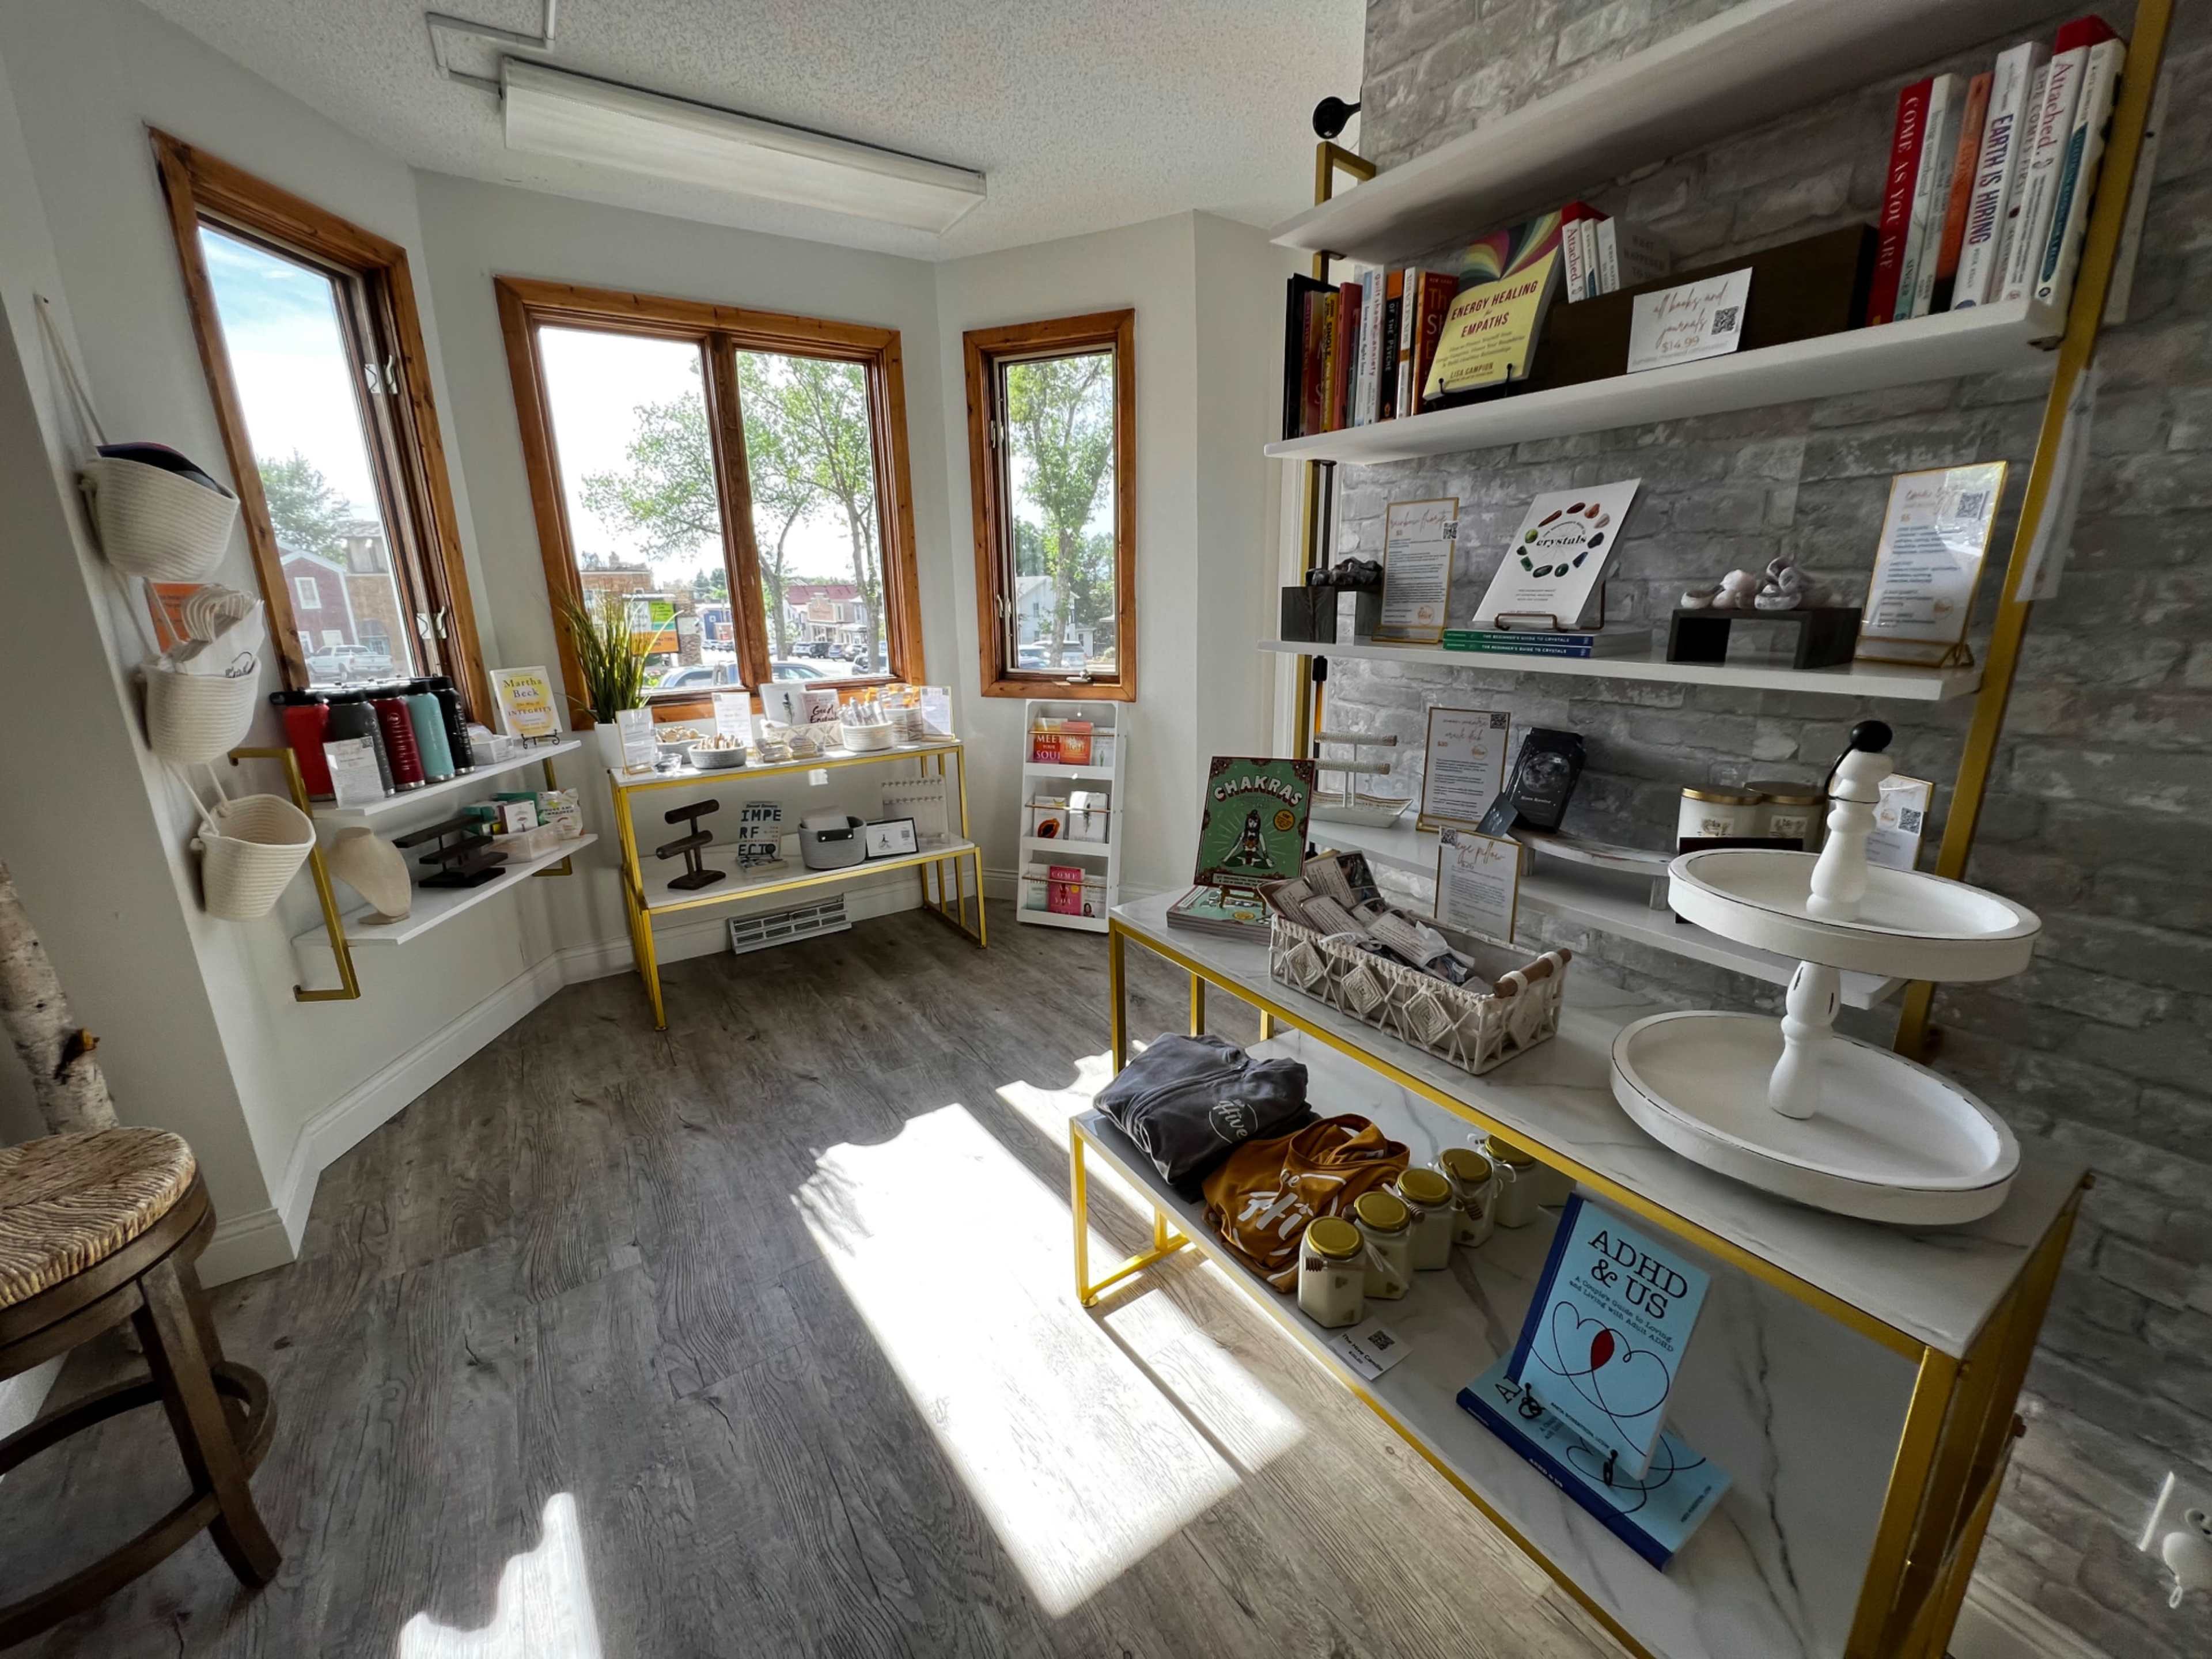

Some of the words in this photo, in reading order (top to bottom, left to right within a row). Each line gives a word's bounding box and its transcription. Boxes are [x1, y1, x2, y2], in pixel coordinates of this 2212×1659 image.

[2037, 63, 2073, 153] Attached.
[1897, 97, 1919, 154] COME
[1984, 113, 2014, 169] EARTH
[1893, 161, 1909, 183] AS
[1979, 169, 2001, 187] IS
[1885, 188, 1905, 224] YOU
[1969, 189, 2000, 246] HIRING
[1567, 229, 1582, 287] Attached.
[1878, 235, 1897, 270] ARE
[1429, 288, 1447, 310] Th
[1450, 296, 1490, 321] ENERGY
[1491, 281, 1539, 307] HEALING
[1461, 312, 1509, 338] EMPATHS
[1384, 339, 1395, 371] PSYCHE
[1536, 535, 1586, 548] crystals
[503, 677, 543, 688] Martha
[512, 687, 539, 698] Beck
[507, 706, 552, 716] INTEGRITY
[1036, 735, 1062, 743] MEET
[1214, 775, 1303, 806] CHAKRAS
[741, 809, 782, 822] IMPE
[739, 826, 759, 839] RF
[1051, 872, 1077, 880] COME
[1281, 1169, 1301, 1188] he
[1588, 1230, 1688, 1298] ADHD
[1591, 1259, 1618, 1289] &
[1625, 1275, 1668, 1319] US
[1569, 1280, 1582, 1292] and
[1583, 1289, 1606, 1309] Living
[1608, 1307, 1624, 1321] with
[1625, 1319, 1647, 1336] Adult
[1649, 1334, 1674, 1352] ADHD
[1612, 1300, 1634, 1317] Guide
[1635, 1316, 1644, 1324] to
[1645, 1321, 1673, 1343] Loving
